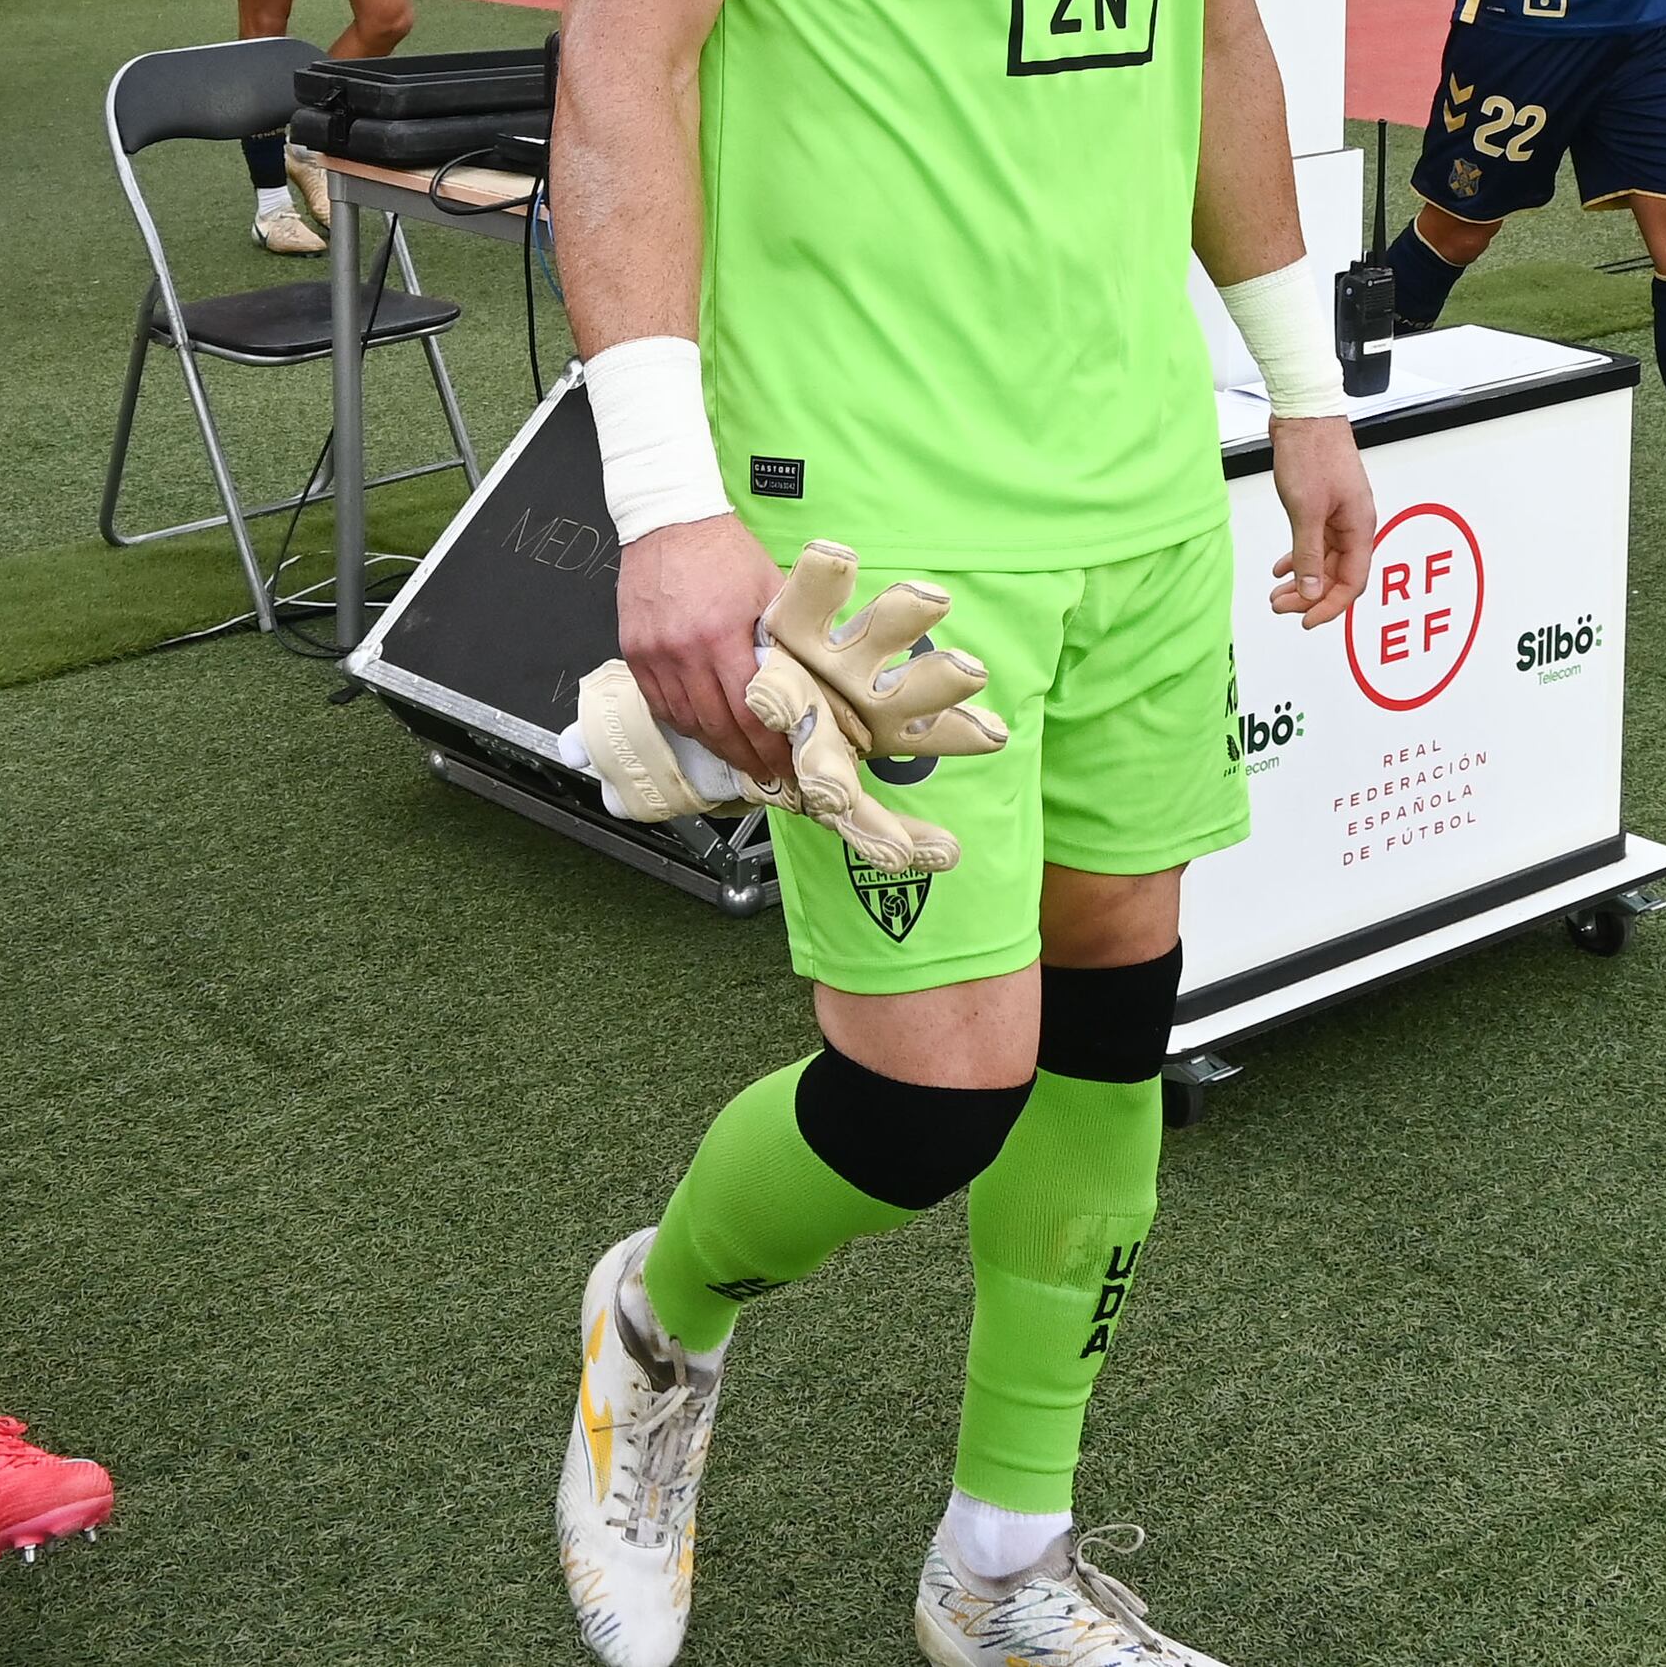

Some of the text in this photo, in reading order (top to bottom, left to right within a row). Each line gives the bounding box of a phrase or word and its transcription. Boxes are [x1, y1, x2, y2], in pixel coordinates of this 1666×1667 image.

[1473, 94, 1547, 163] 22
[754, 463, 796, 475] CASTORE
[1381, 549, 1454, 608] RF
[1379, 607, 1452, 665] EF
[1537, 662, 1582, 686] Telecom
[1238, 700, 1295, 756] lbö
[1382, 738, 1442, 769] REAL
[1245, 755, 1280, 776] ecom
[1334, 750, 1488, 813] FEDERACIÓN
[1347, 782, 1473, 837] ESPAÑOLA
[1343, 809, 1477, 867] DE FÚTBOL
